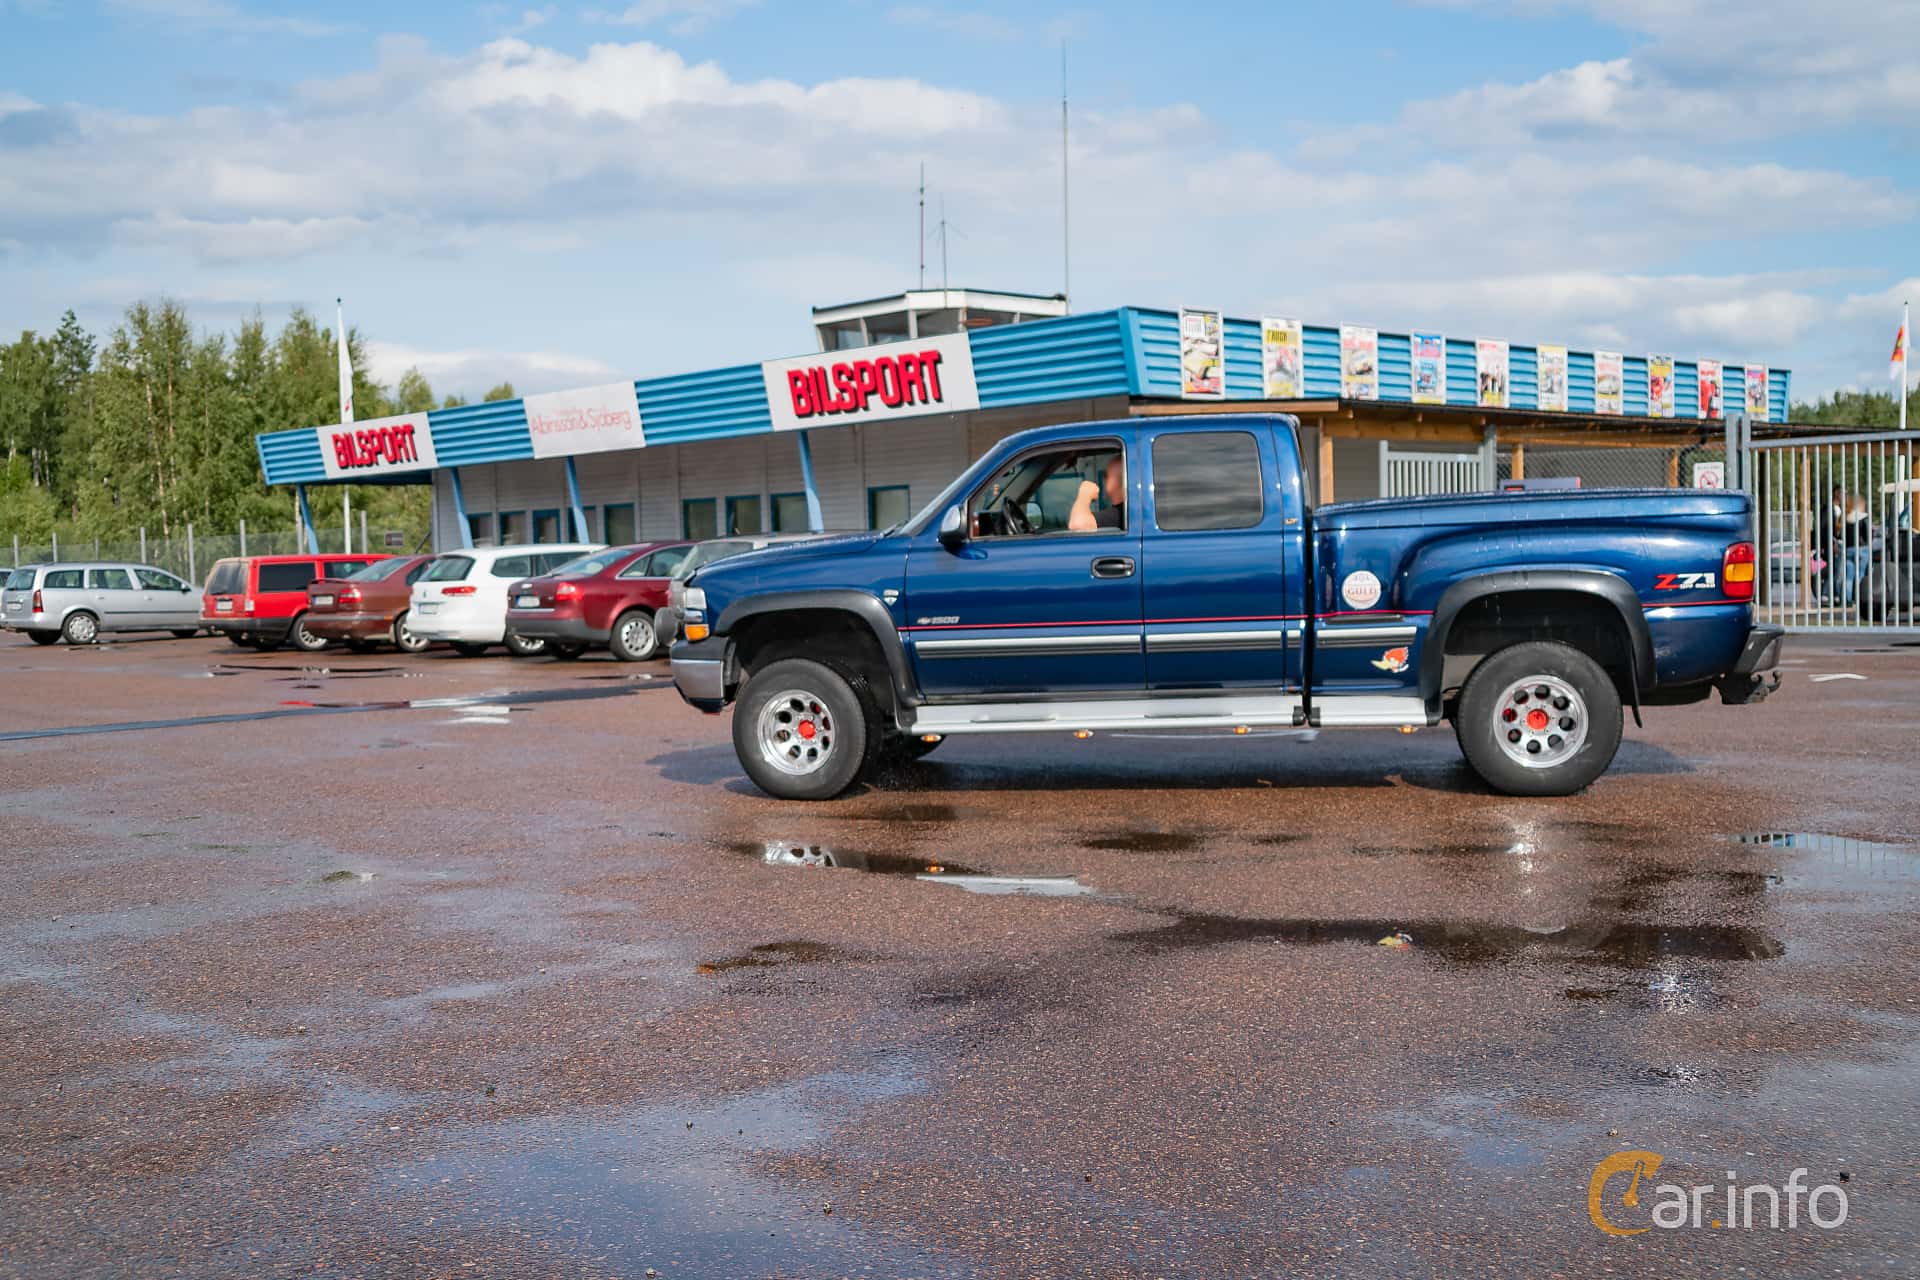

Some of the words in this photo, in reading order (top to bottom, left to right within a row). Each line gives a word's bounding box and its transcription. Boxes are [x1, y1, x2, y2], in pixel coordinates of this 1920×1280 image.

[787, 350, 942, 418] BILSPORT
[332, 423, 417, 468] BILSPORT
[1654, 572, 1715, 590] Z71
